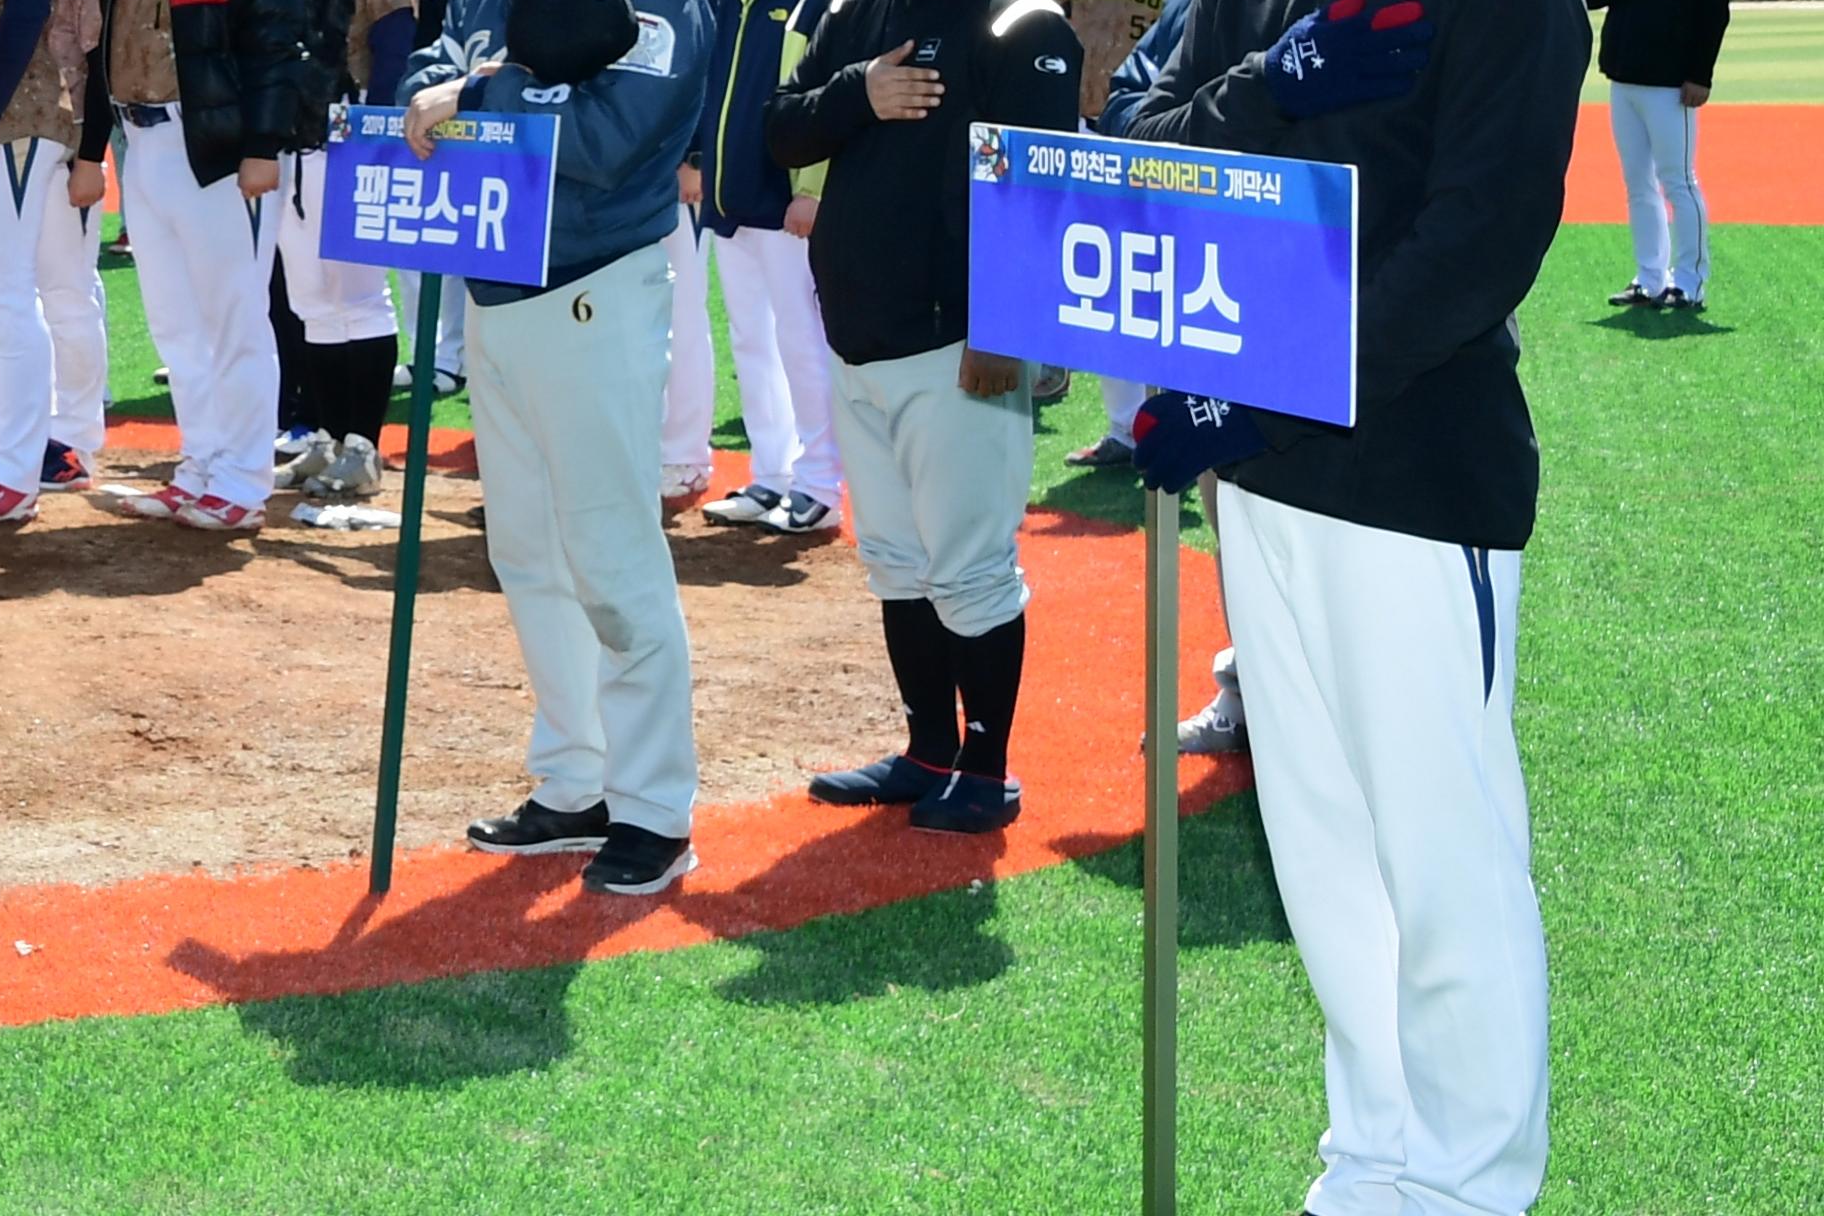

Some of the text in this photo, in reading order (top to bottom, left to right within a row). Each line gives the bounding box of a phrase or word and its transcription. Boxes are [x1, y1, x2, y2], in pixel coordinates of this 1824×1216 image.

[1129, 14, 1159, 41] 5
[361, 115, 386, 136] 2019
[1028, 145, 1281, 205] 2019 화천군 산천어리그 개막식
[353, 164, 509, 252] 팰콘스-R
[572, 290, 593, 323] 6
[1058, 222, 1242, 355] 오터스
